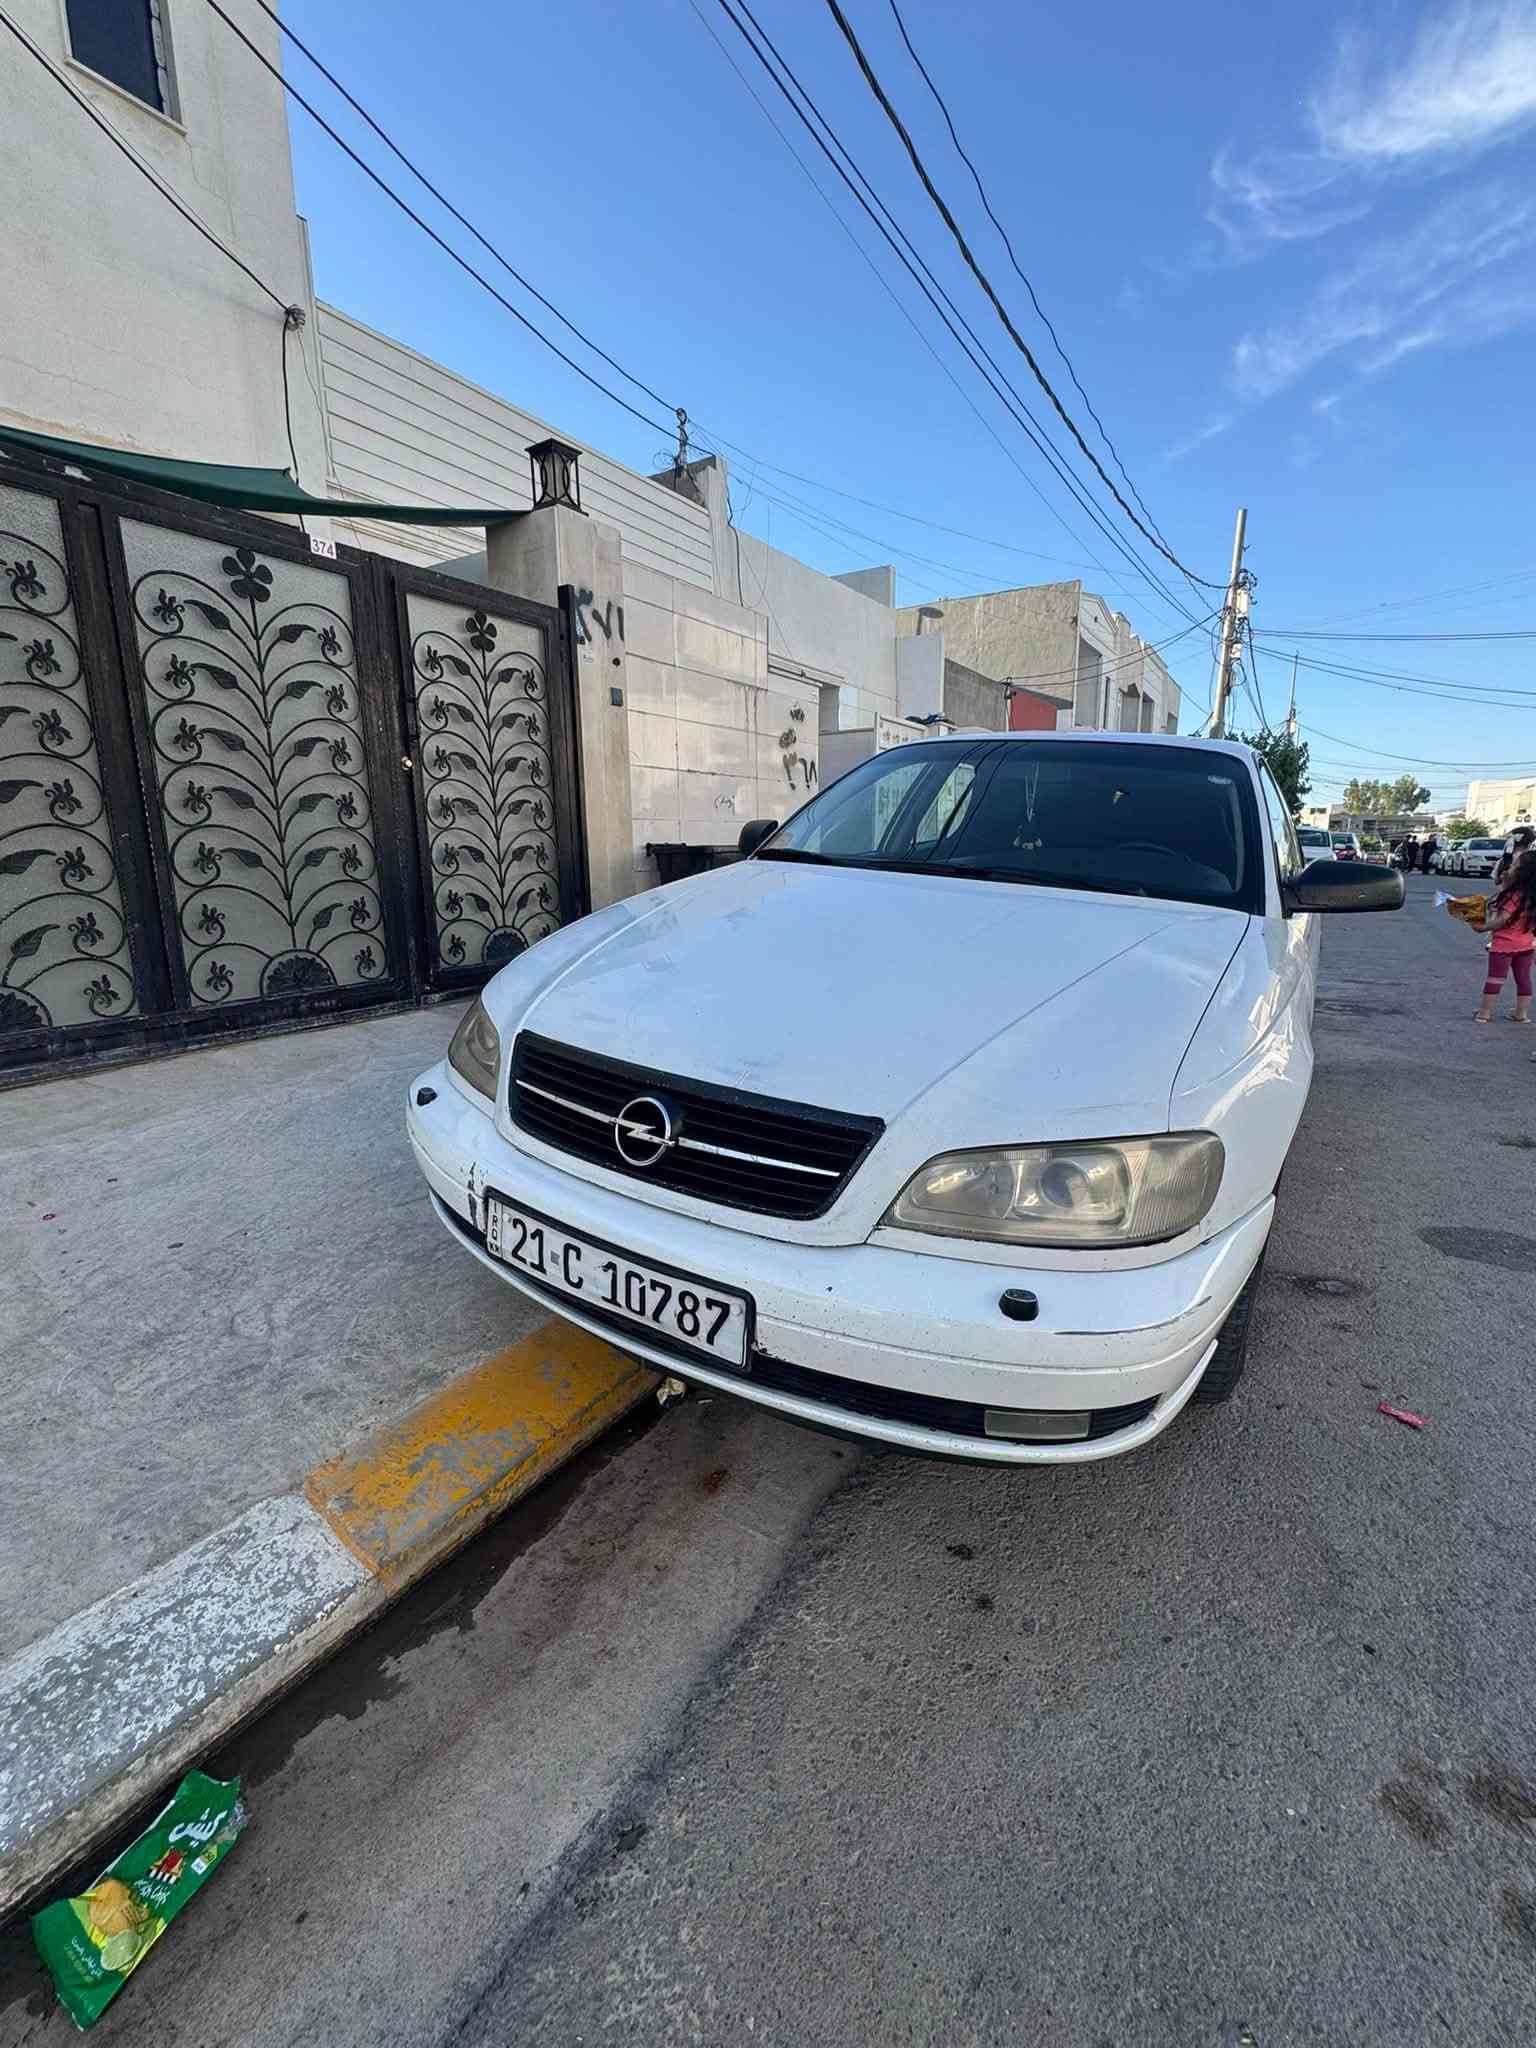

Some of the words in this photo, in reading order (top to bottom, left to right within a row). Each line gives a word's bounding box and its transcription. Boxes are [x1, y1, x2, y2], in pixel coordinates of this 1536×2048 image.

[312, 539, 334, 556] 374
[511, 1217, 547, 1275] 21
[563, 1242, 584, 1289] C
[601, 1261, 731, 1346] 10787
